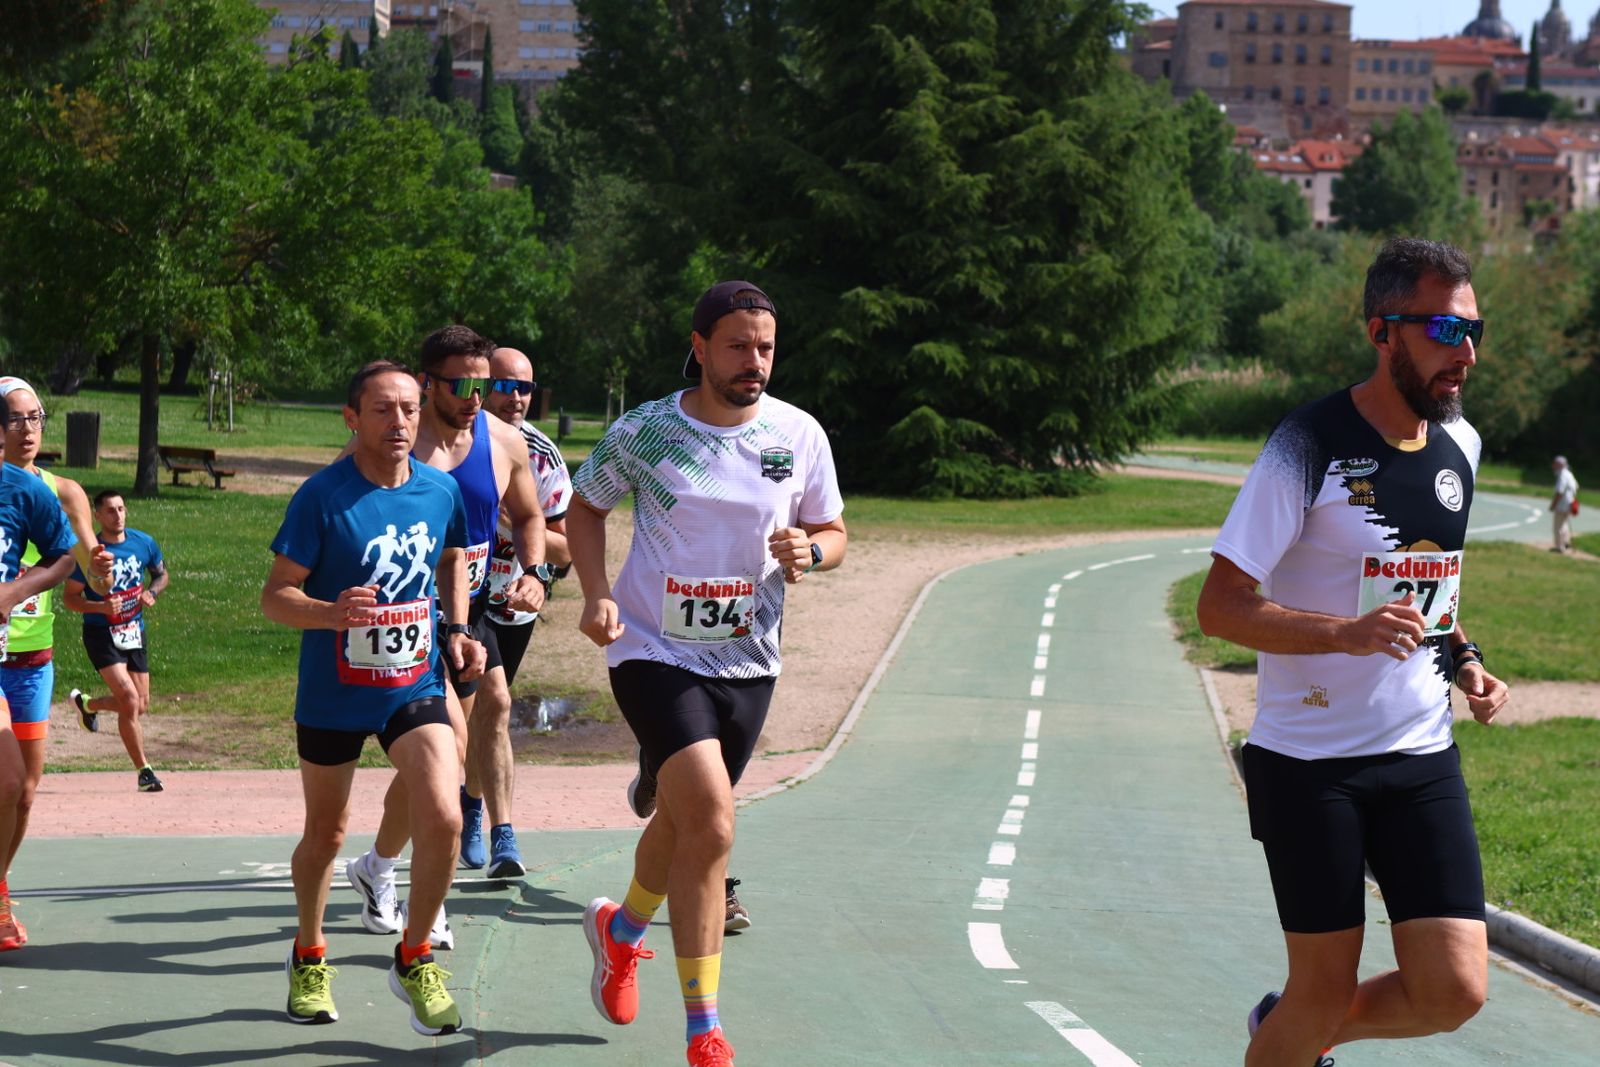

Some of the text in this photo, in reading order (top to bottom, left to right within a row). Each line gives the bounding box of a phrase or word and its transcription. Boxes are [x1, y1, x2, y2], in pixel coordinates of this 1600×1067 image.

[666, 577, 753, 599] bedunia
[369, 606, 429, 626] dunia
[680, 598, 741, 629] 134
[366, 623, 420, 656] 139
